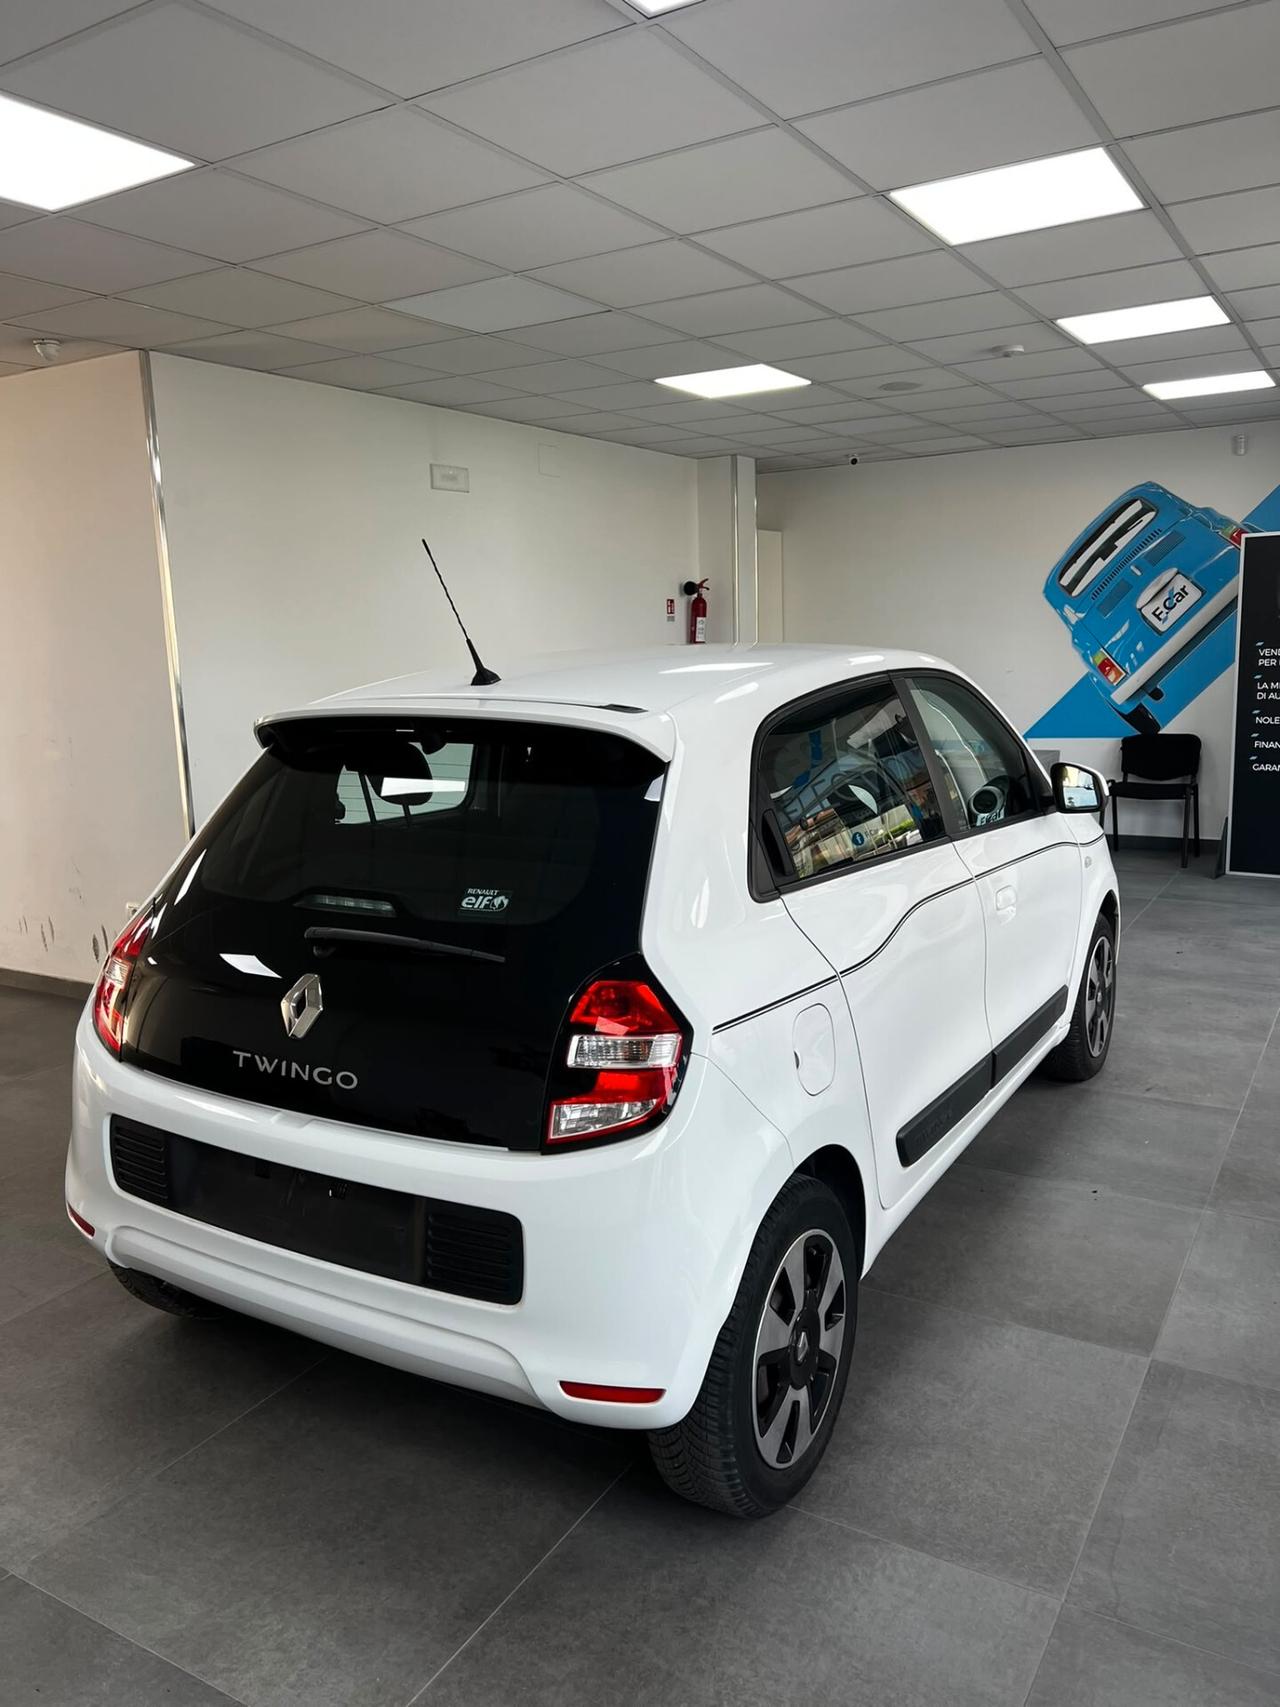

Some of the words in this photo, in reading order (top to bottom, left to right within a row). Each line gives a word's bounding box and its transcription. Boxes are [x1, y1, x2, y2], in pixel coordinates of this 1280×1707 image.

[1258, 658, 1277, 667] PER
[1257, 682, 1269, 690] LA
[1256, 692, 1267, 700] DI
[1255, 716, 1280, 725] NOLE
[467, 888, 499, 896] RENAULT
[461, 895, 493, 909] elf
[232, 1050, 358, 1090] TWINGO
